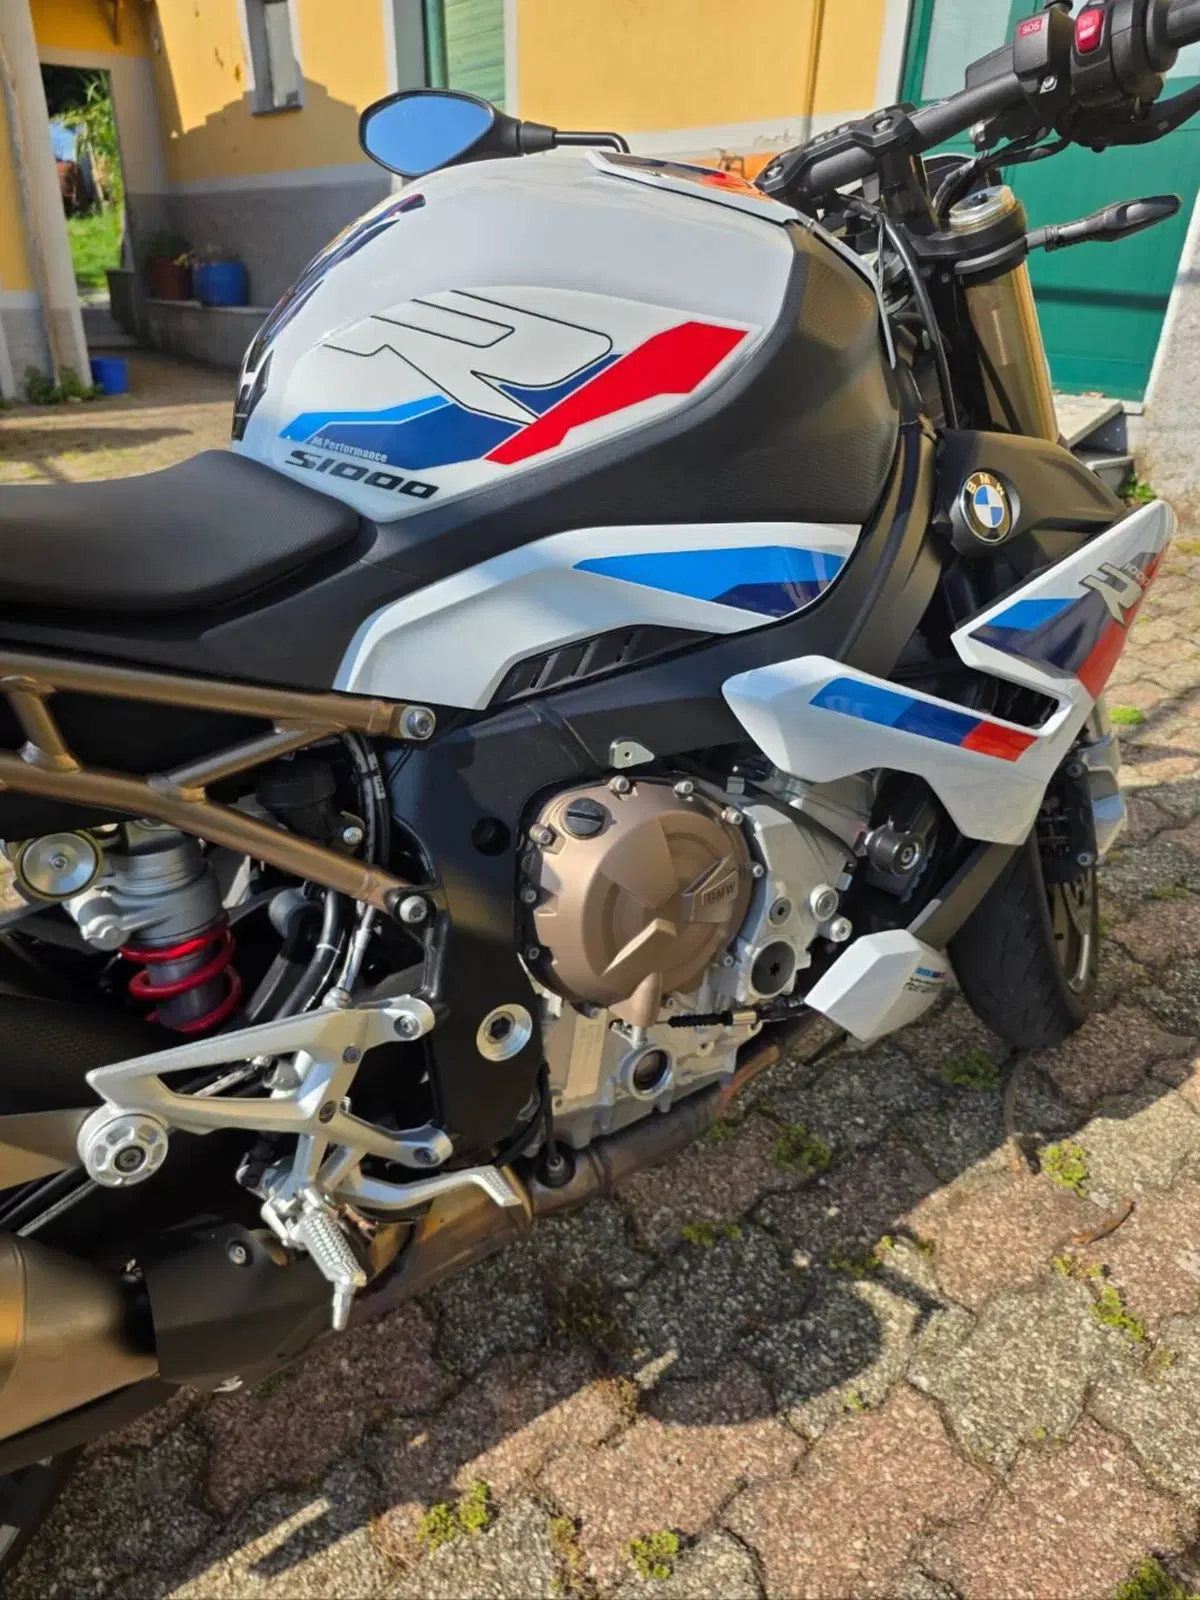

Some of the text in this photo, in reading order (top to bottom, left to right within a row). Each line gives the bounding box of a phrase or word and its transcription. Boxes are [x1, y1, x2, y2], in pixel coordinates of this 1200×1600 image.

[1021, 22, 1041, 36] SOS
[323, 438, 388, 463] Performance
[285, 450, 439, 499] S1000
[966, 473, 1005, 497] BMW
[707, 880, 736, 903] BMW
